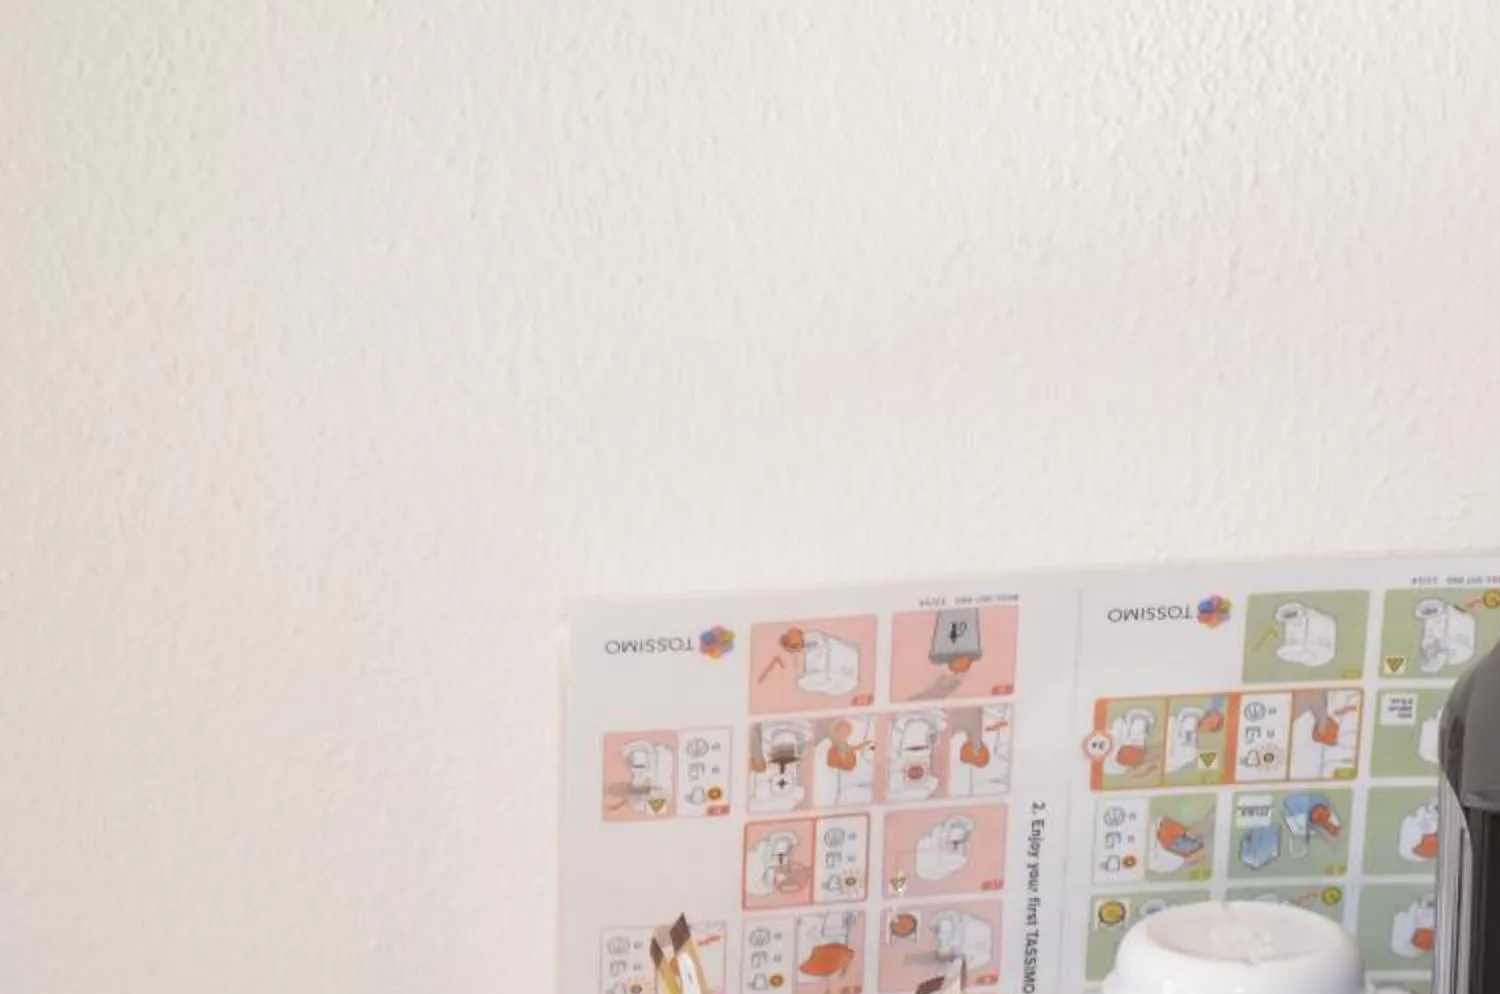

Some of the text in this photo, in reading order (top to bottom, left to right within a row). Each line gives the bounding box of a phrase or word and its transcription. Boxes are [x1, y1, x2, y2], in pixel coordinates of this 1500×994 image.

[1026, 819, 1045, 857] Enjoy
[1026, 862, 1040, 893] your
[1022, 929, 1040, 994] TASSIMO
